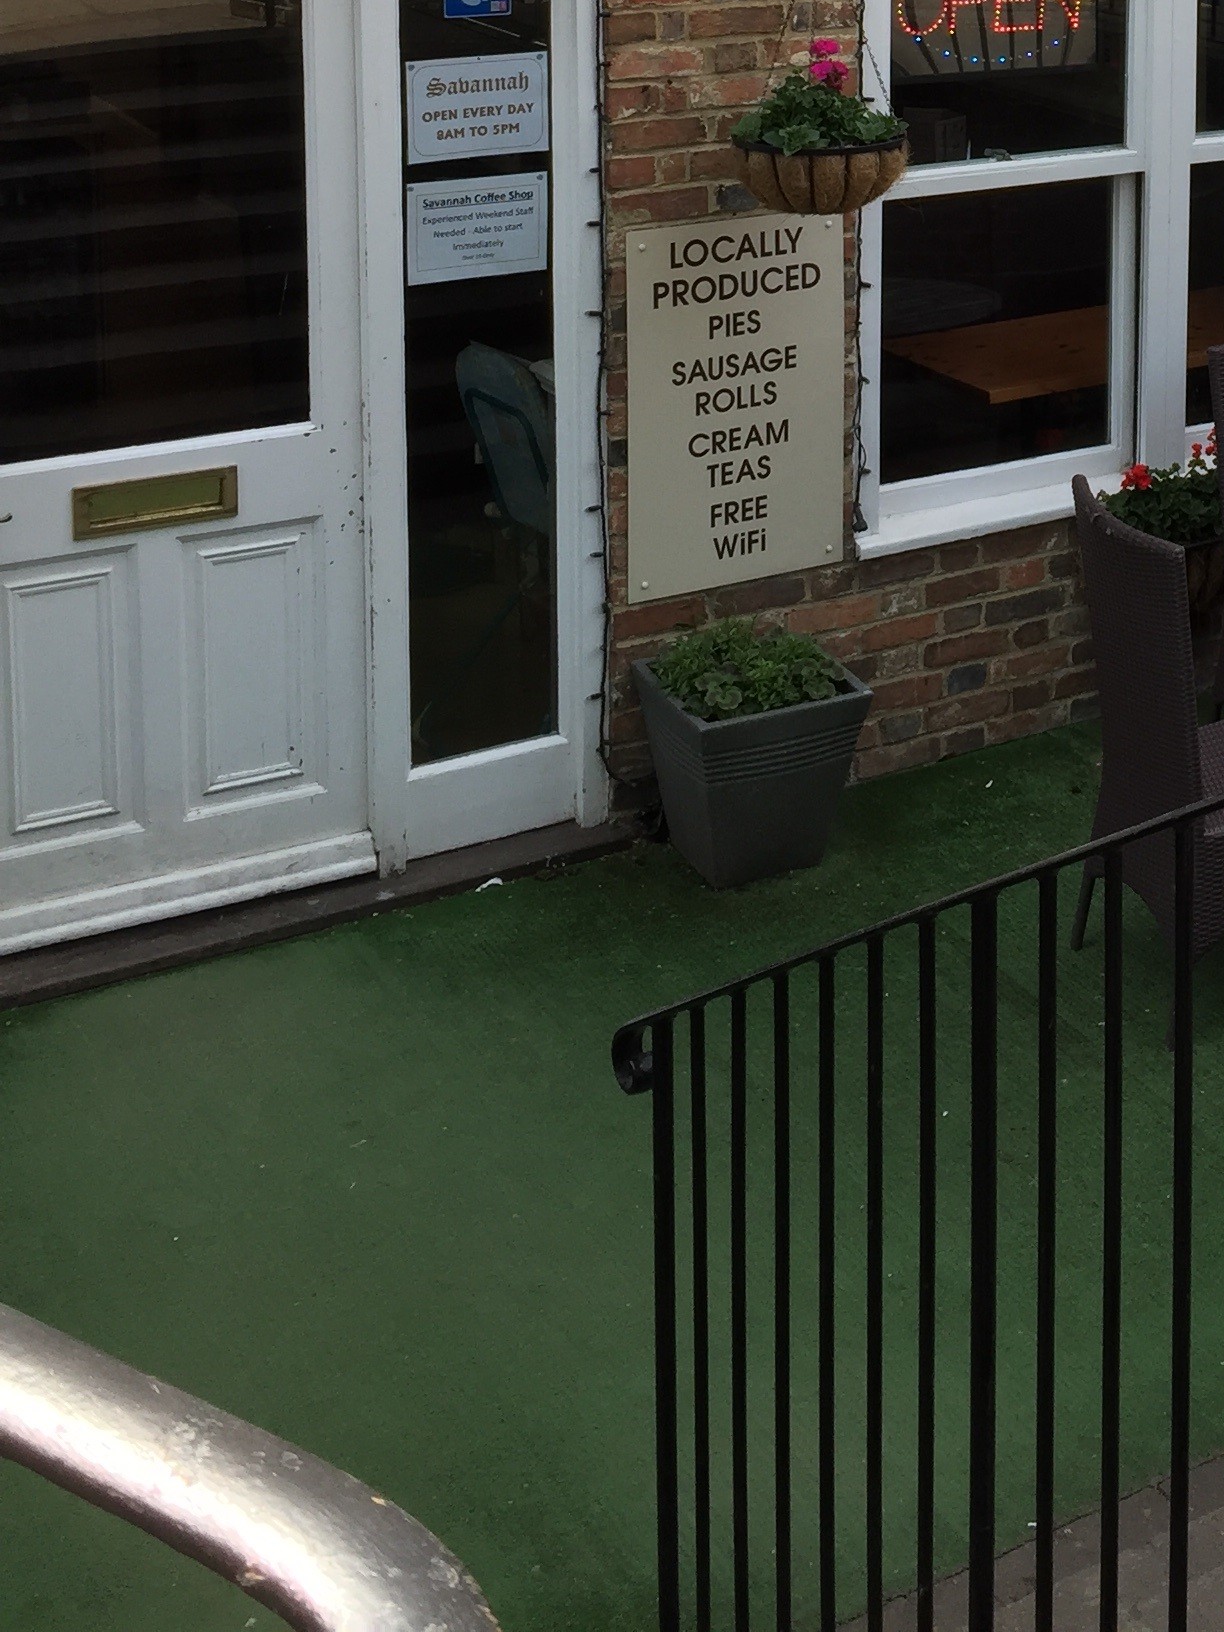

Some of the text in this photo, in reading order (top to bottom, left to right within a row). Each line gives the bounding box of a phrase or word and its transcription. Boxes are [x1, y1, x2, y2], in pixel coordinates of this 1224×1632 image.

[426, 70, 529, 99] Savannah
[422, 102, 535, 123] OPEN EVERY DAY
[436, 122, 520, 141] 8AM TO 5PM
[422, 189, 534, 209] Savannah Coffee Shop
[422, 206, 534, 226] Experienced Weekend Staff
[433, 227, 466, 239] Needed
[472, 226, 491, 235] Able
[504, 222, 523, 232] start
[669, 226, 804, 270] LOCALLY
[652, 262, 821, 310] PRODUCED
[708, 310, 762, 340] PIES
[671, 344, 798, 387] SAUSAGE
[694, 381, 778, 417] ROLLS
[687, 419, 790, 458] CREAM
[706, 455, 772, 489] TEAS
[709, 495, 768, 529] FREE
[713, 528, 768, 561] WiFi
